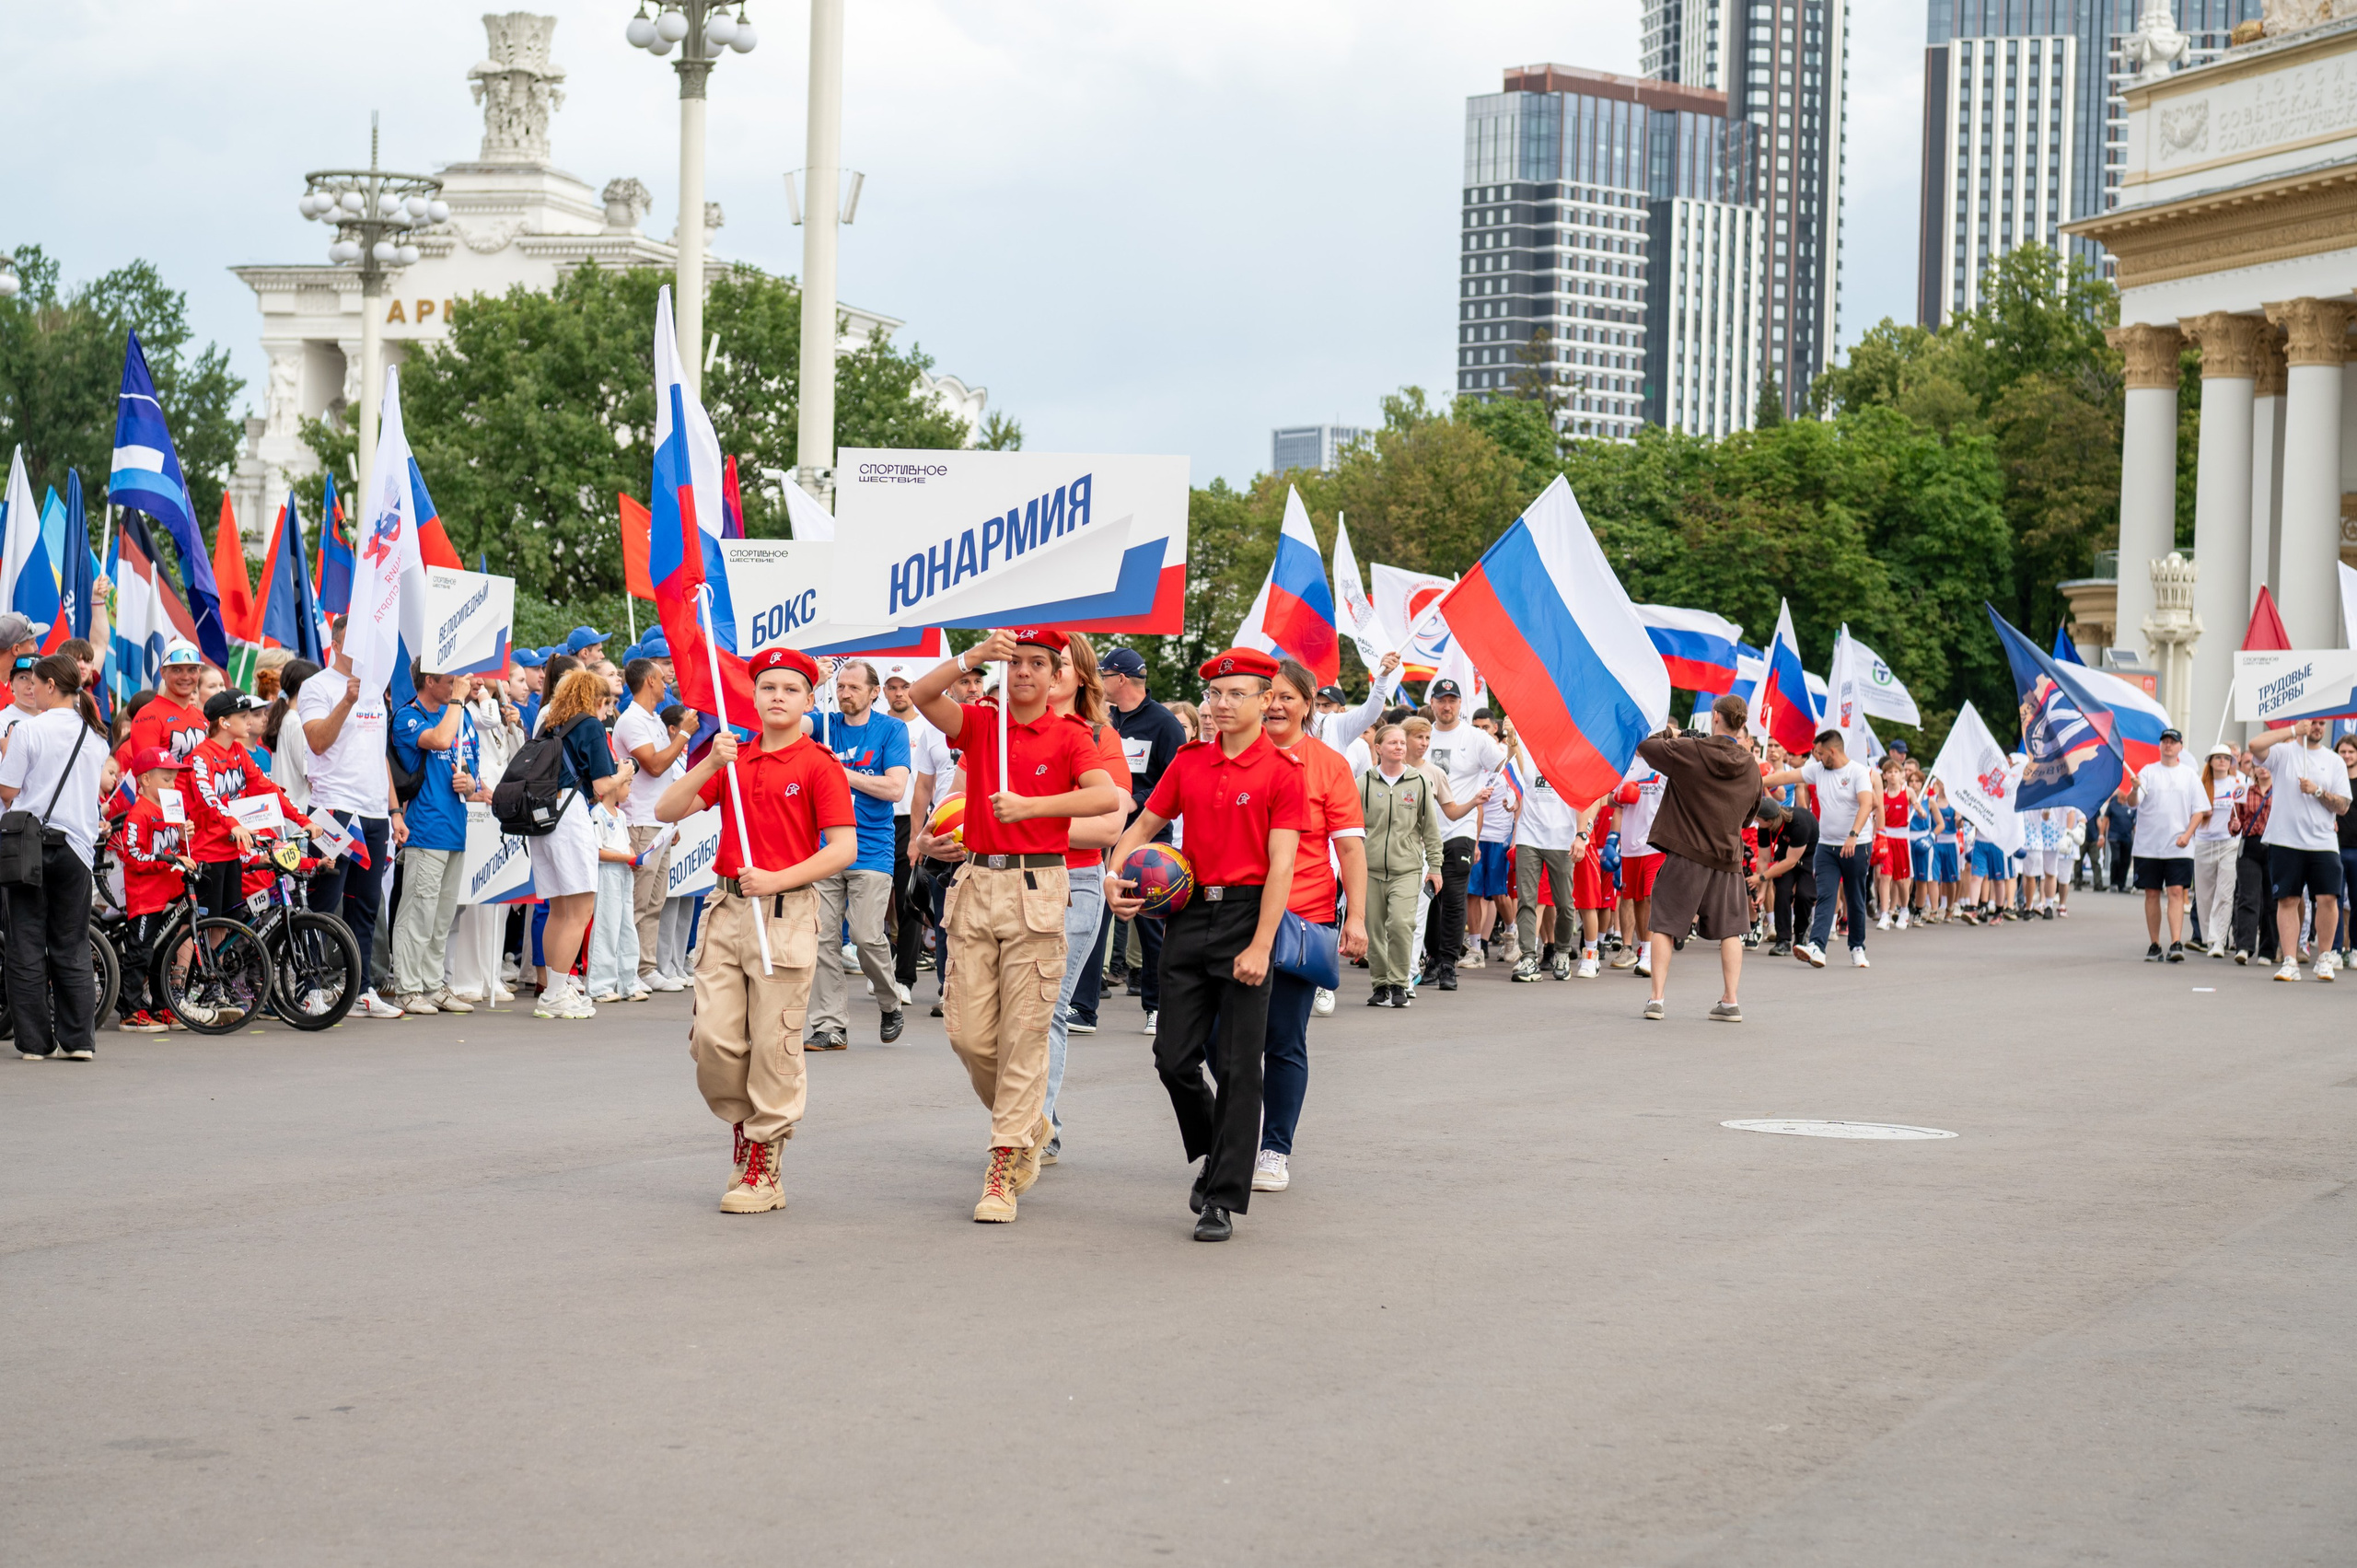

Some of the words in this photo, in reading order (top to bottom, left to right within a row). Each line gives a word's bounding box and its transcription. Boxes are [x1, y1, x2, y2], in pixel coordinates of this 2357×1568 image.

[2218, 102, 2357, 153] СОЦИАЛИСТИЧЕСК
[859, 463, 947, 476] СПОРТИВНОЕ
[859, 476, 926, 484] ШЕСТВИЕ
[729, 549, 789, 558] СПОРТИВНОЕ
[889, 472, 1092, 616] ЮНАРМИЯ
[438, 579, 490, 645] ВЕЛОСИПЕДНЫЙ
[751, 588, 817, 649] БОКС
[437, 633, 458, 667] СПОРТ
[2258, 662, 2313, 702] ТРУДОВЫЕ
[2258, 682, 2304, 716] РЕЗЕРВЫ
[282, 847, 296, 865] 115
[669, 830, 722, 891] ВОЛЕЙБО
[253, 892, 266, 906] 115
